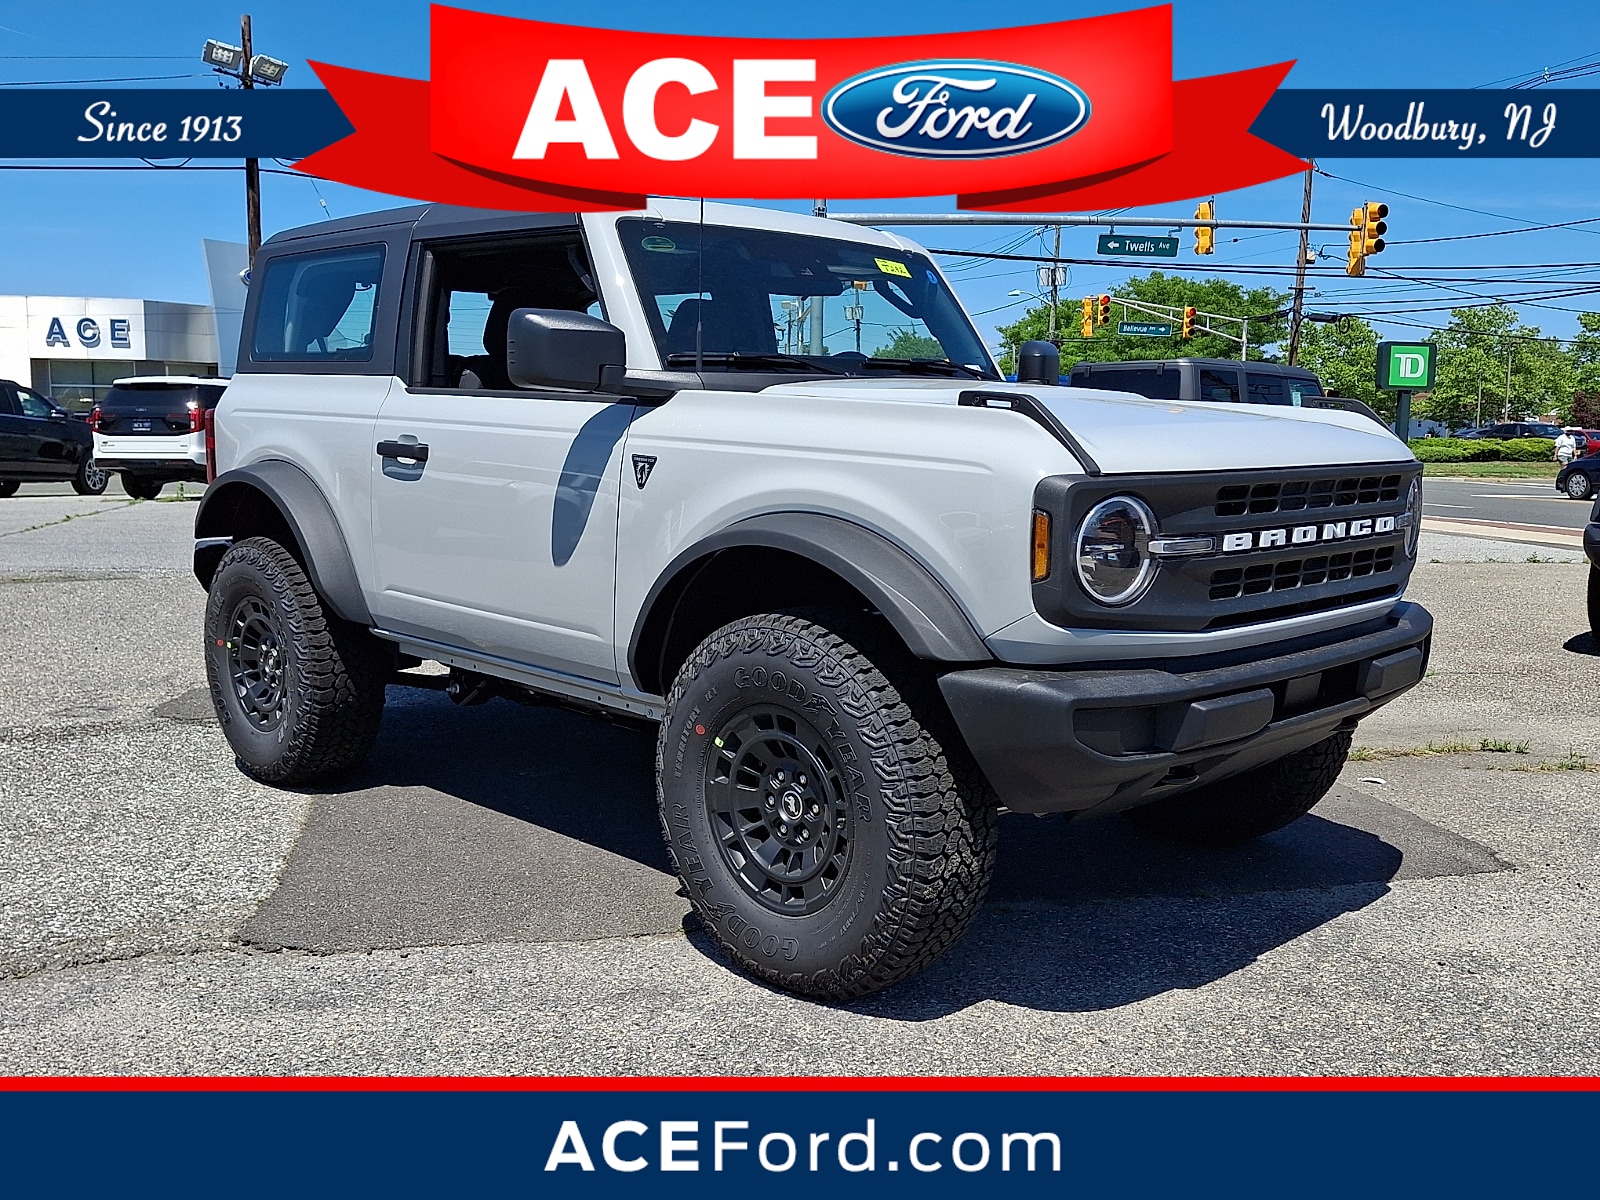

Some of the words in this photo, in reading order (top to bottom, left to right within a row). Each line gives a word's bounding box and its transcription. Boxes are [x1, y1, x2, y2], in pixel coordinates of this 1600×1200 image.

[1125, 240, 1155, 252] Twells
[1158, 241, 1170, 249] Ave
[46, 317, 130, 348] ACE
[1123, 324, 1147, 333] Bellevue
[1394, 353, 1424, 378] TD
[1223, 516, 1395, 552] BRONCO
[674, 705, 701, 778] TERRITORY
